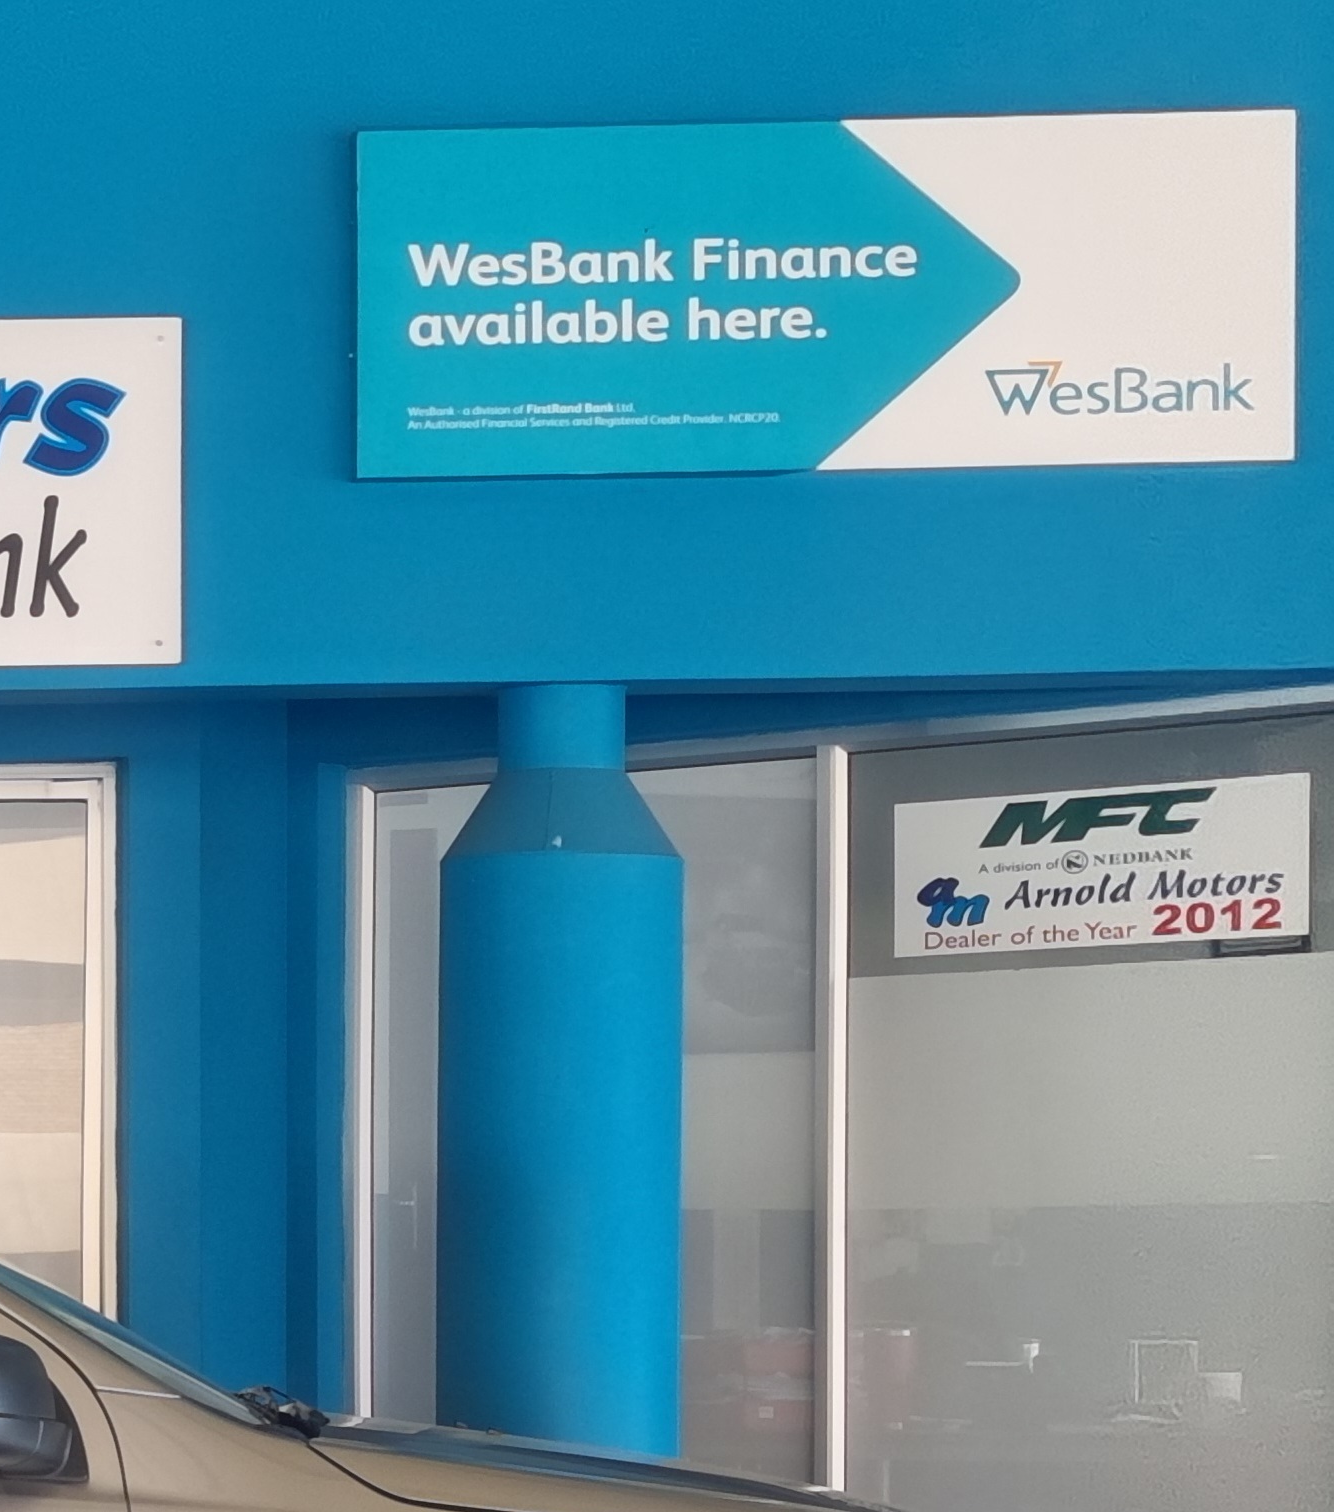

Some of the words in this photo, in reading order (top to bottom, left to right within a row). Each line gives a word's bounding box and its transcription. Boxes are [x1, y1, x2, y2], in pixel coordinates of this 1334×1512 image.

[409, 238, 673, 287] WesBank
[694, 237, 917, 280] Finance
[409, 297, 669, 347] available
[689, 297, 827, 341] here.
[407, 406, 454, 417] WesBank
[463, 407, 470, 415] a
[472, 405, 511, 416] division
[513, 404, 524, 414] of
[526, 403, 582, 414] FirstRand
[584, 402, 614, 413] Bank
[985, 361, 1254, 418] WesBank
[407, 420, 422, 430] An
[424, 418, 480, 429] Authorised
[482, 417, 528, 428] Financial
[530, 417, 570, 427] Services
[572, 416, 593, 426] and
[594, 414, 648, 428] Registered
[650, 413, 681, 425] Credit
[979, 864, 990, 875] A
[993, 859, 1042, 874] division
[1045, 857, 1060, 872] of
[1093, 847, 1194, 868] NEDBANK
[1004, 870, 1137, 911] Arnold
[1147, 869, 1284, 901] Motors
[924, 927, 1002, 951] Dealer
[1010, 924, 1036, 946] of
[1042, 922, 1080, 944] the
[1084, 921, 1138, 941] Year
[1152, 897, 1282, 936] 2012
